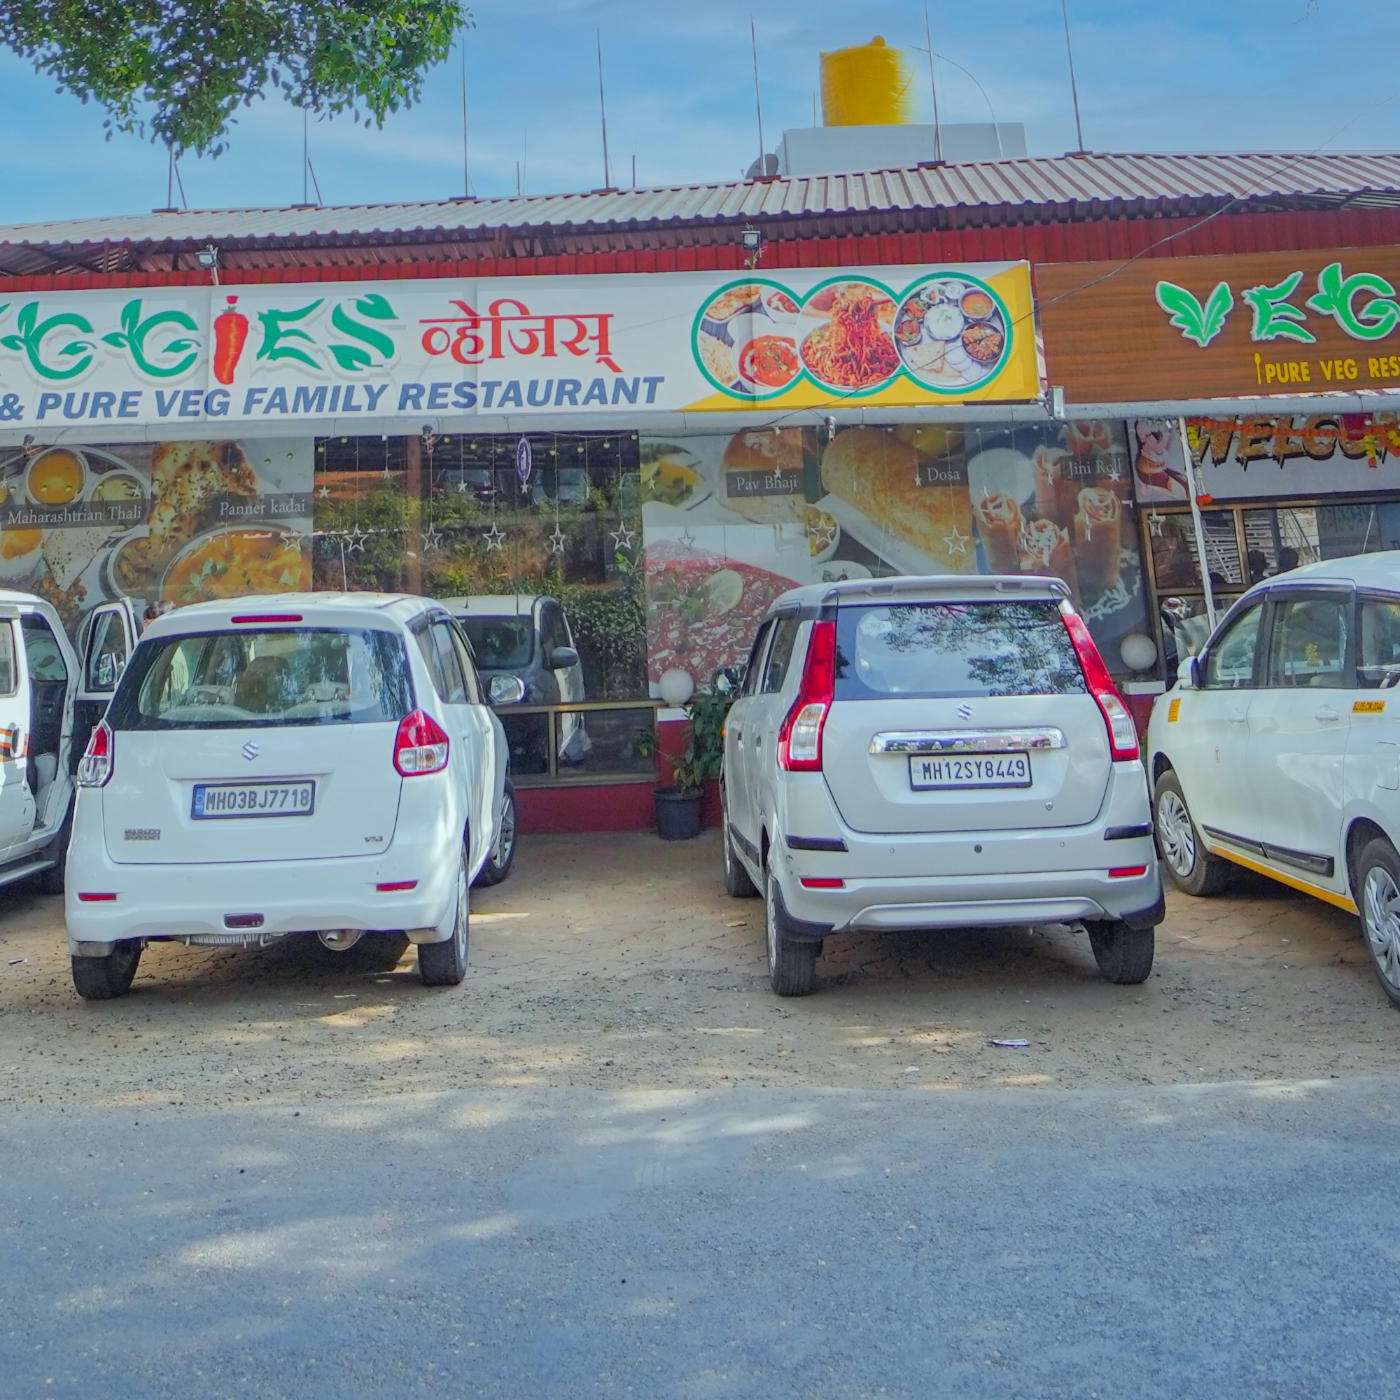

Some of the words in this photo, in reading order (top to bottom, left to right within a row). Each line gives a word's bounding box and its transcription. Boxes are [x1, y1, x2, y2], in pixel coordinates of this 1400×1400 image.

[1265, 361, 1310, 384] PURE
[1320, 358, 1358, 380] VEG
[0, 392, 25, 422] &
[36, 390, 142, 420] PURE
[155, 388, 232, 416] VEG
[243, 383, 390, 415] FAMILY
[398, 376, 665, 410] RESTAURANT
[736, 477, 760, 490] Pav
[765, 472, 798, 492] Bhaji
[928, 467, 960, 482] Dosa
[8, 507, 101, 525] Maharashtrian
[108, 504, 141, 520] Thali
[220, 500, 266, 517] Panner
[271, 499, 305, 515] kadai
[922, 760, 1025, 780] MH12SY8449
[206, 789, 309, 811] MH03BJ7718
